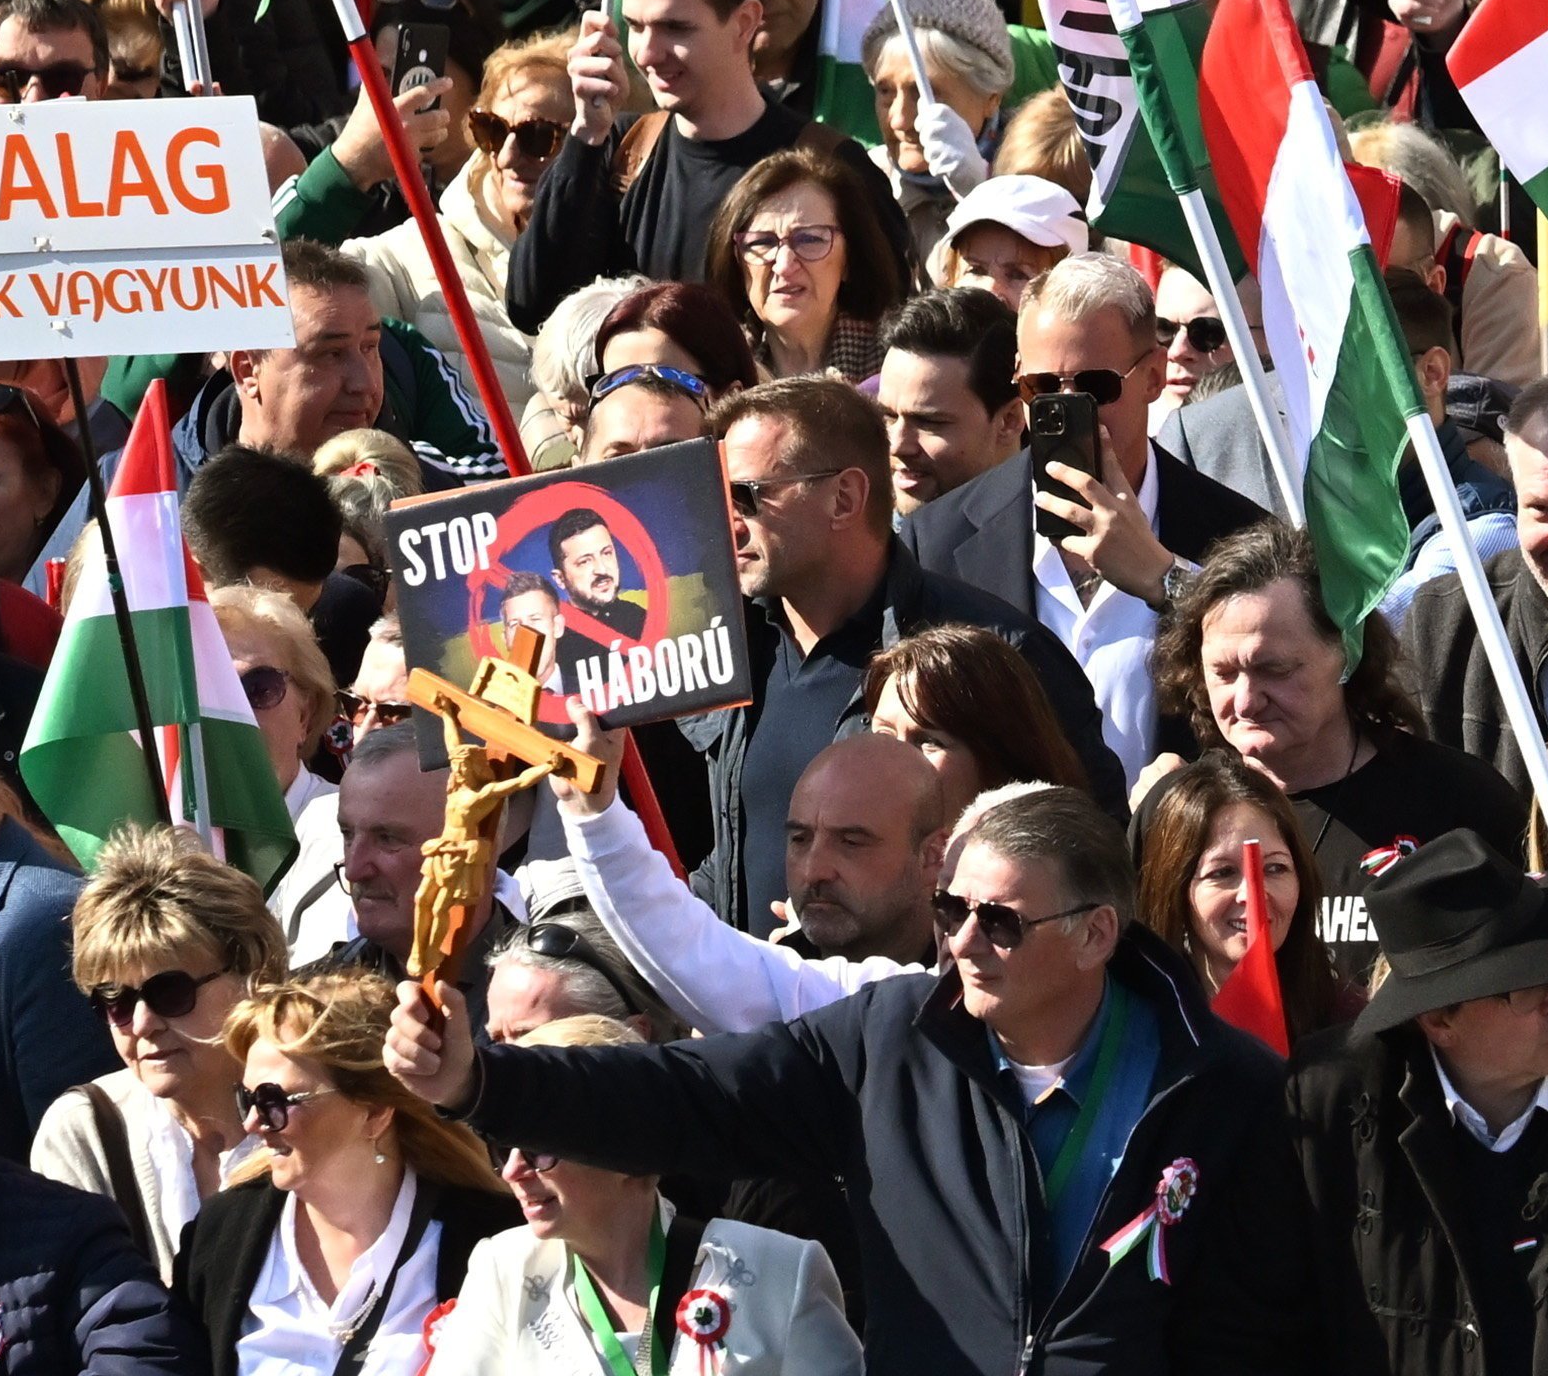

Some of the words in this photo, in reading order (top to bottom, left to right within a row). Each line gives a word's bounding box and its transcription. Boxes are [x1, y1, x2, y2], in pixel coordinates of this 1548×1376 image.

[29, 262, 286, 324] VAGYUNK
[398, 511, 499, 587] STOP
[575, 615, 735, 714] HÁBORÚ
